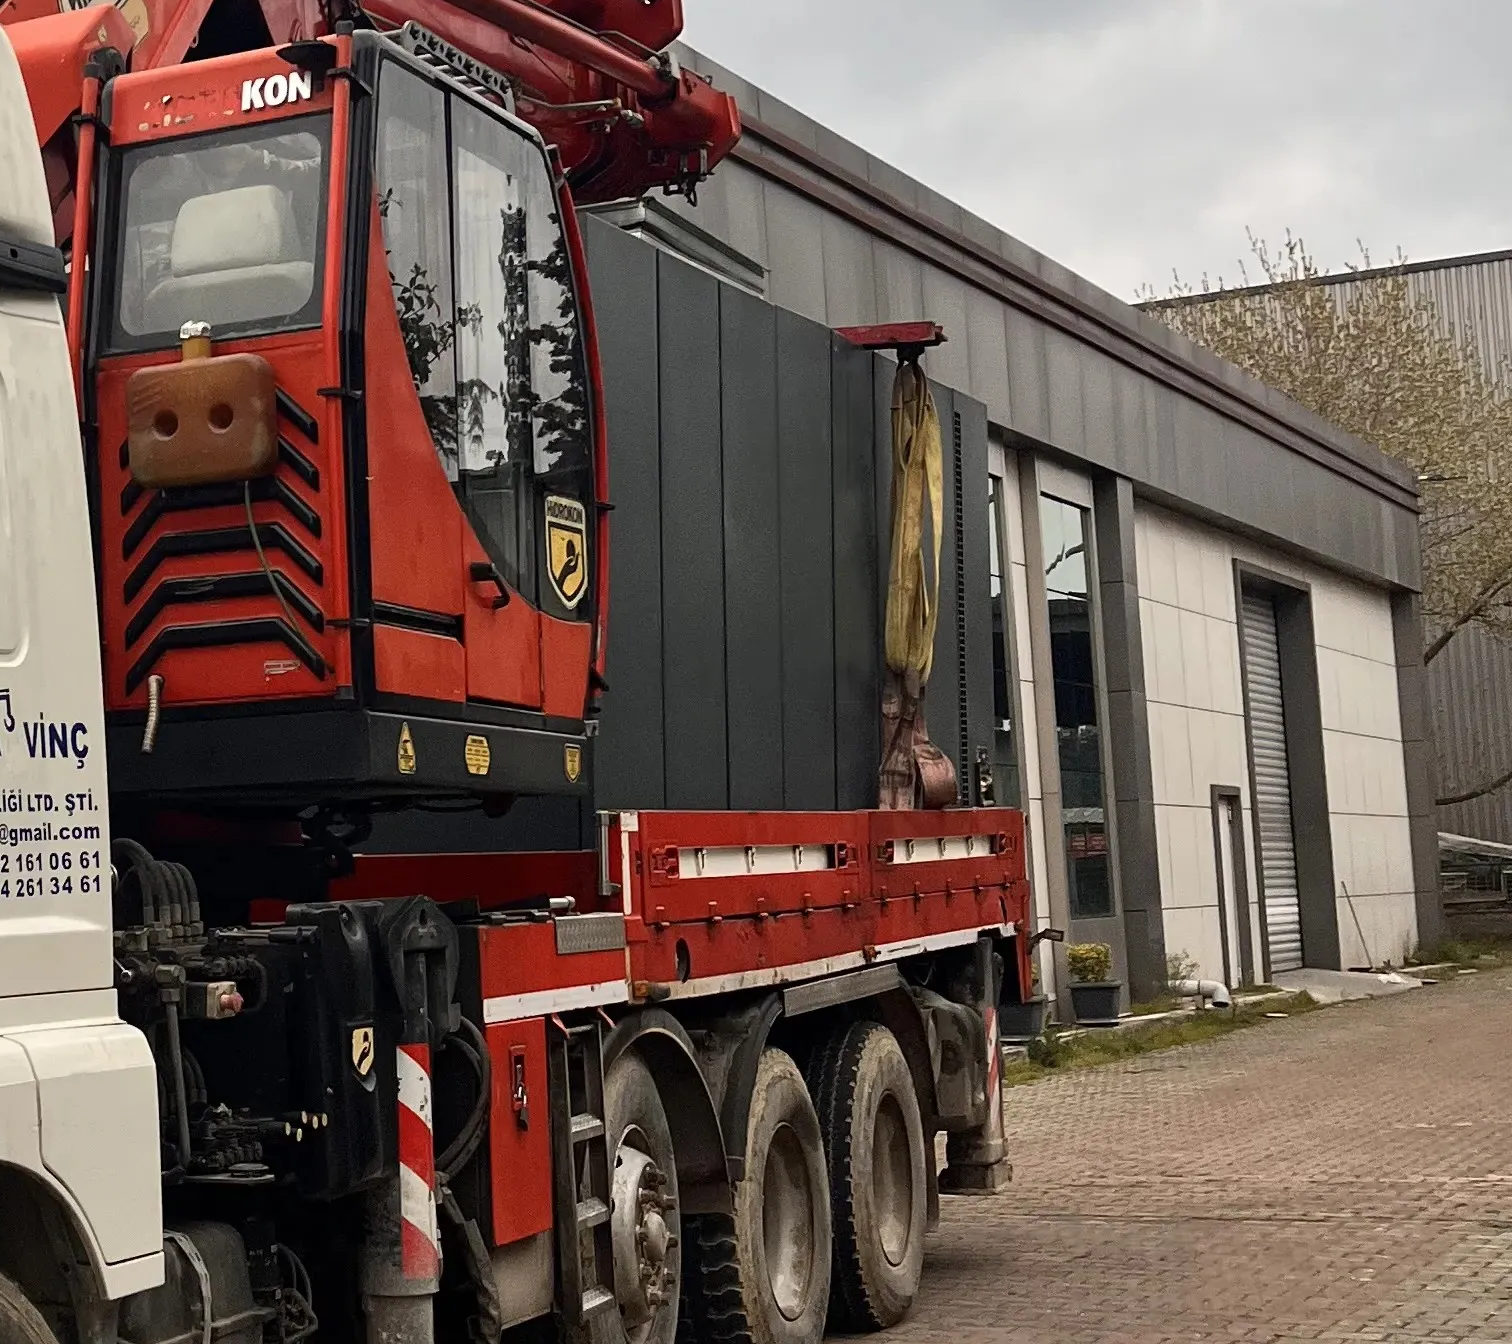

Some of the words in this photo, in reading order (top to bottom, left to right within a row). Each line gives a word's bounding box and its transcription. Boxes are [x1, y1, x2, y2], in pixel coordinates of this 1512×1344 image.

[241, 71, 312, 112] KON
[23, 712, 89, 769] VİNÇ
[27, 794, 59, 812] LTD.
[15, 853, 43, 872] 161
[49, 852, 72, 870] 06
[79, 851, 100, 869] 61
[16, 878, 44, 896] 261
[50, 876, 73, 895] 34
[80, 875, 101, 892] 61
